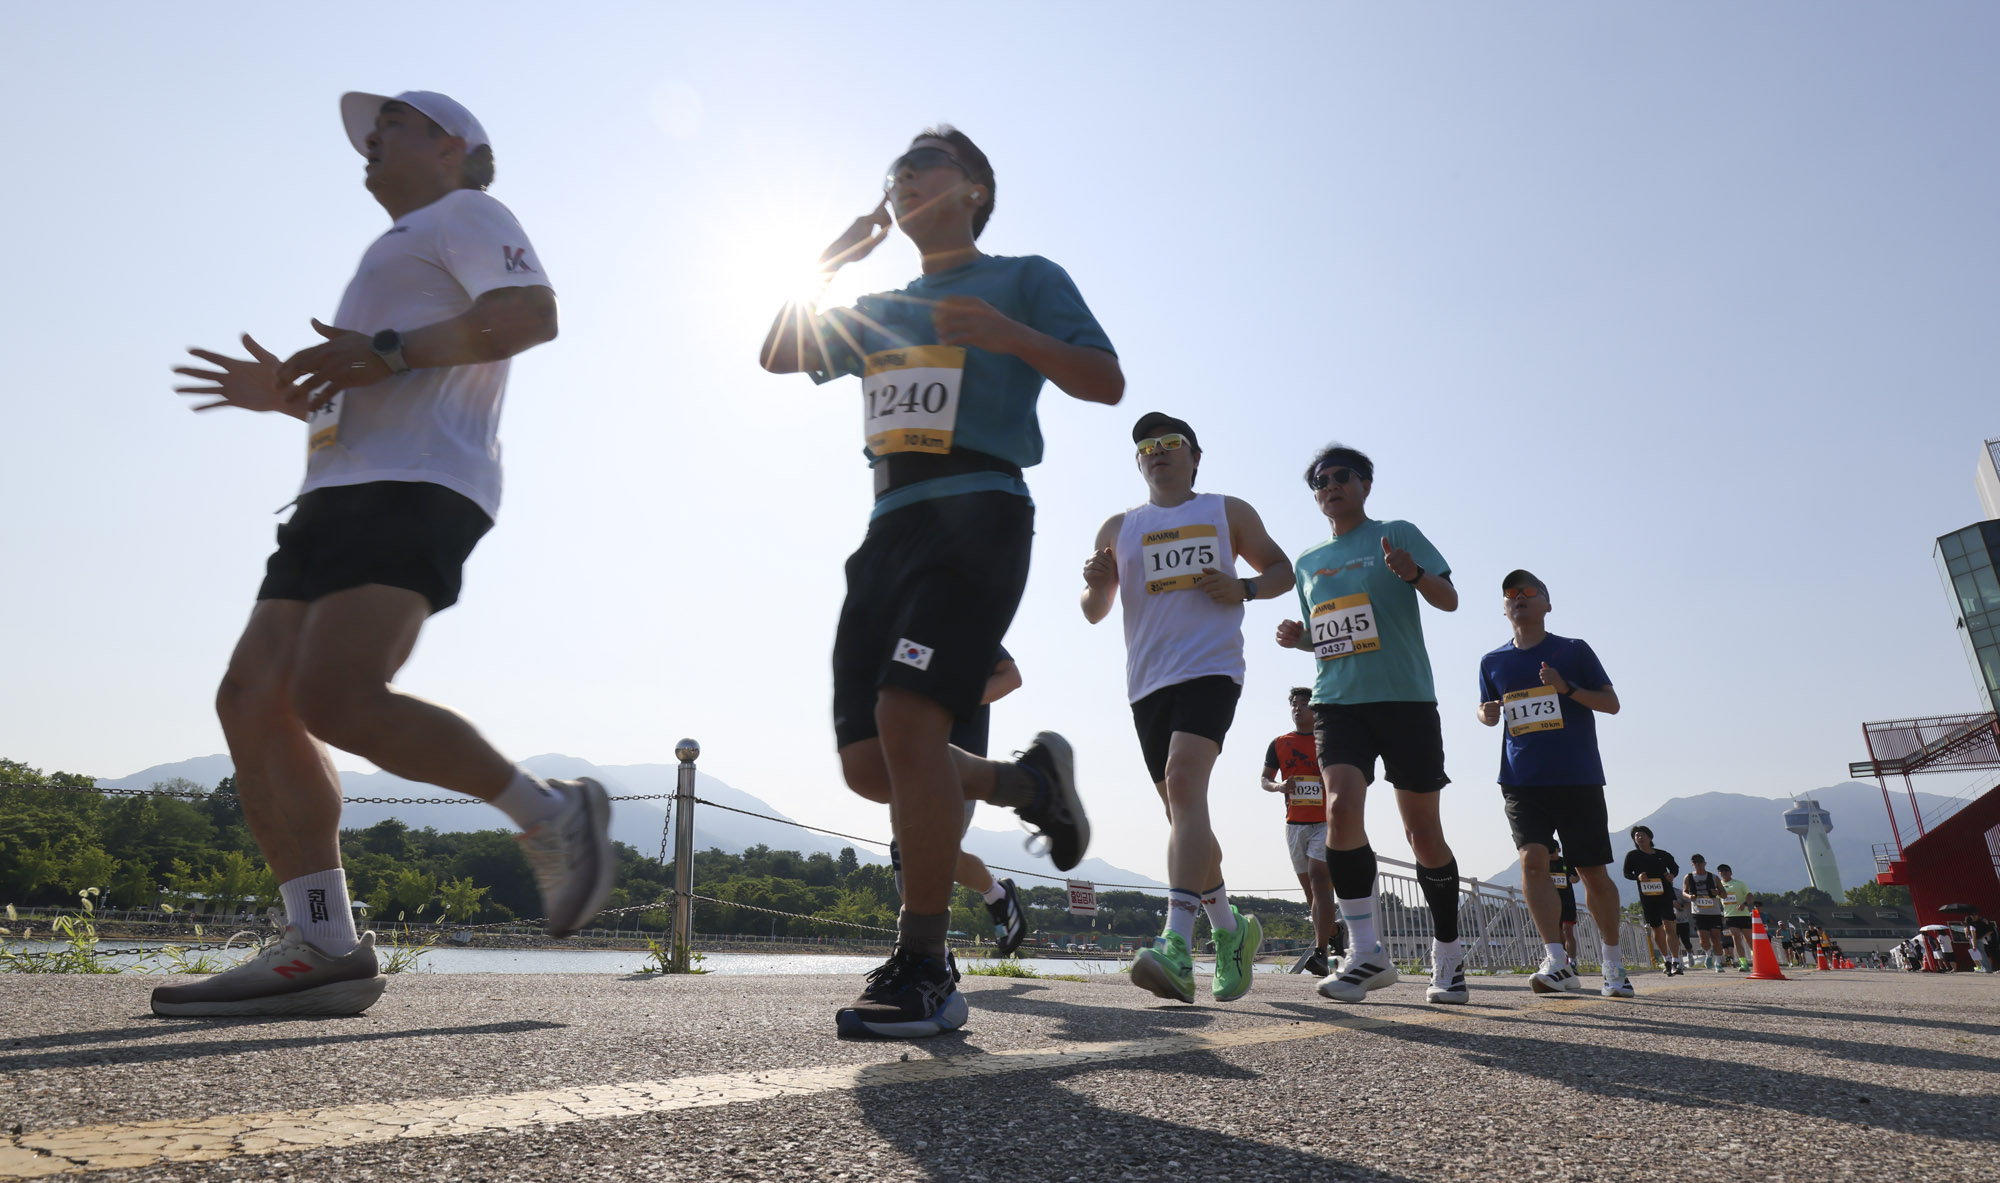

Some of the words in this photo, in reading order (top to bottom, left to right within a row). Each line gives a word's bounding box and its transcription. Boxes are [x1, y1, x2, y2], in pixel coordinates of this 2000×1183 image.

[868, 382, 948, 420] 1240
[1152, 545, 1214, 572] 1075
[1315, 613, 1369, 640] 7045
[1322, 643, 1346, 655] 0437
[1511, 701, 1555, 720] 1173
[1292, 785, 1320, 796] 029
[1071, 890, 1095, 905] 출입금지
